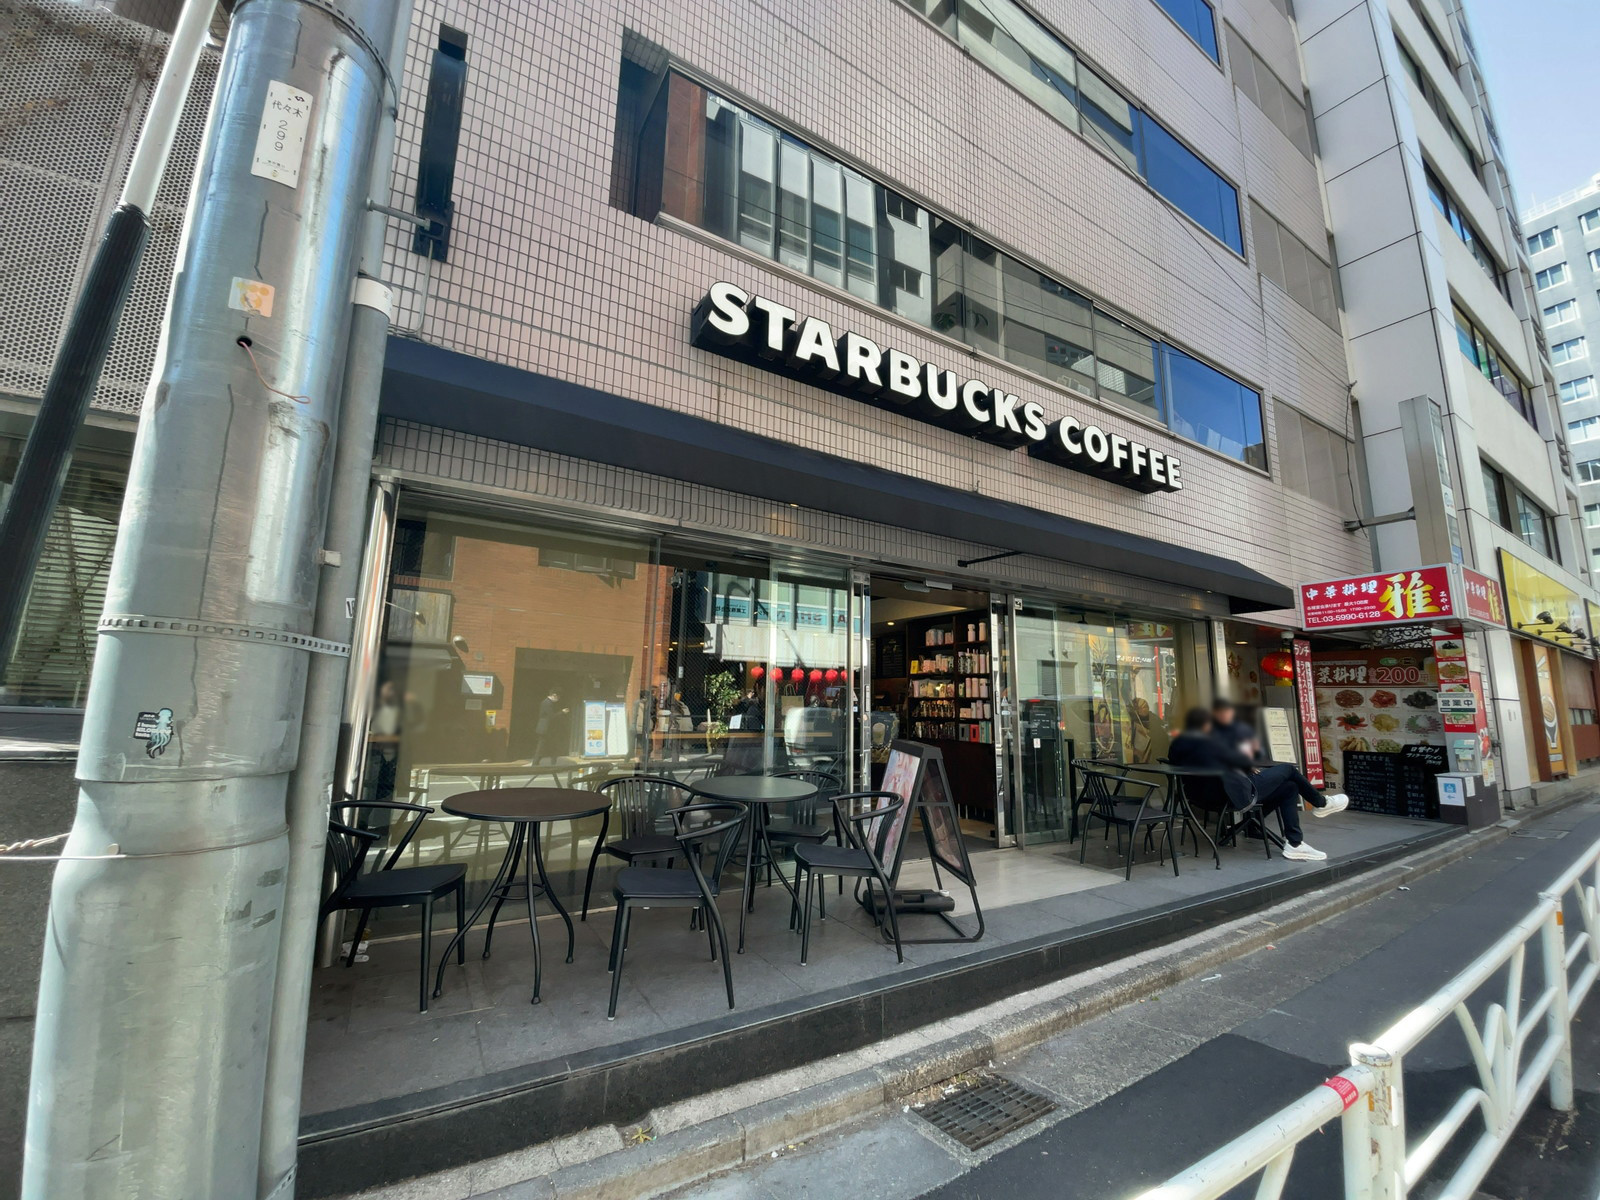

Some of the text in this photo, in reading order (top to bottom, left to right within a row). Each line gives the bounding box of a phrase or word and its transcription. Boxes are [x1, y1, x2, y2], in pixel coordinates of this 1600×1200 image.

[272, 99, 303, 118] 代々木
[707, 281, 1184, 491] STARBUCKS COFFEE
[1306, 579, 1378, 601] 中華料理
[1379, 571, 1441, 619] 雅
